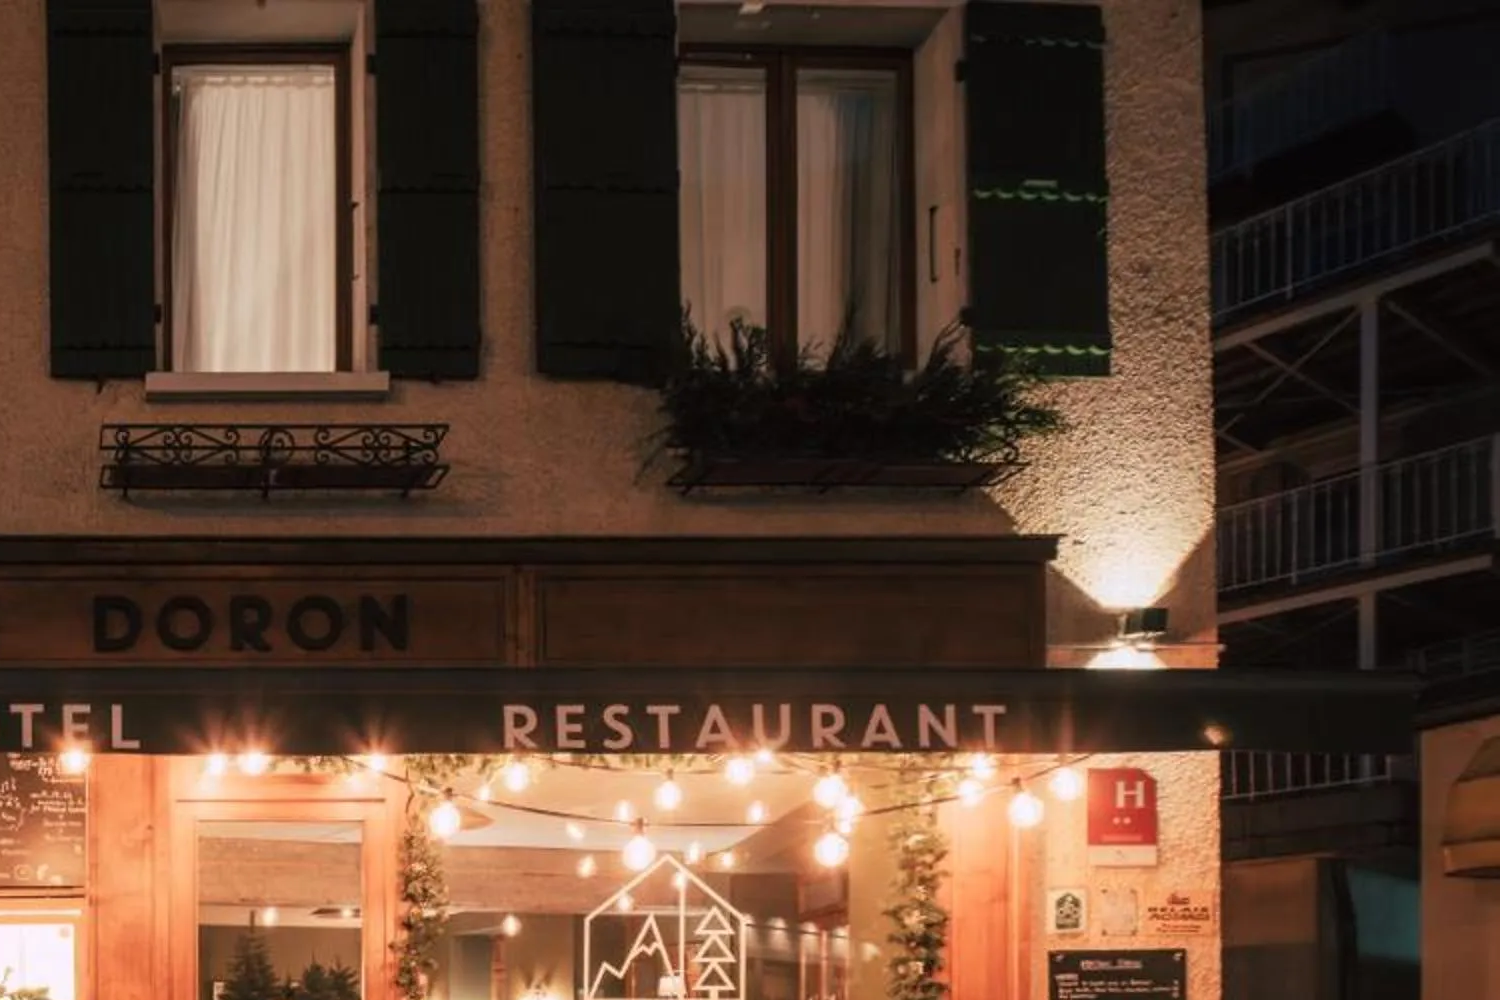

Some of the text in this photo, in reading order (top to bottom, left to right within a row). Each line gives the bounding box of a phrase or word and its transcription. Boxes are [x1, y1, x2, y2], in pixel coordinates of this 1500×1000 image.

[93, 592, 410, 652] DORON
[502, 703, 1007, 750] RESTAURANT
[1115, 780, 1145, 809] H
